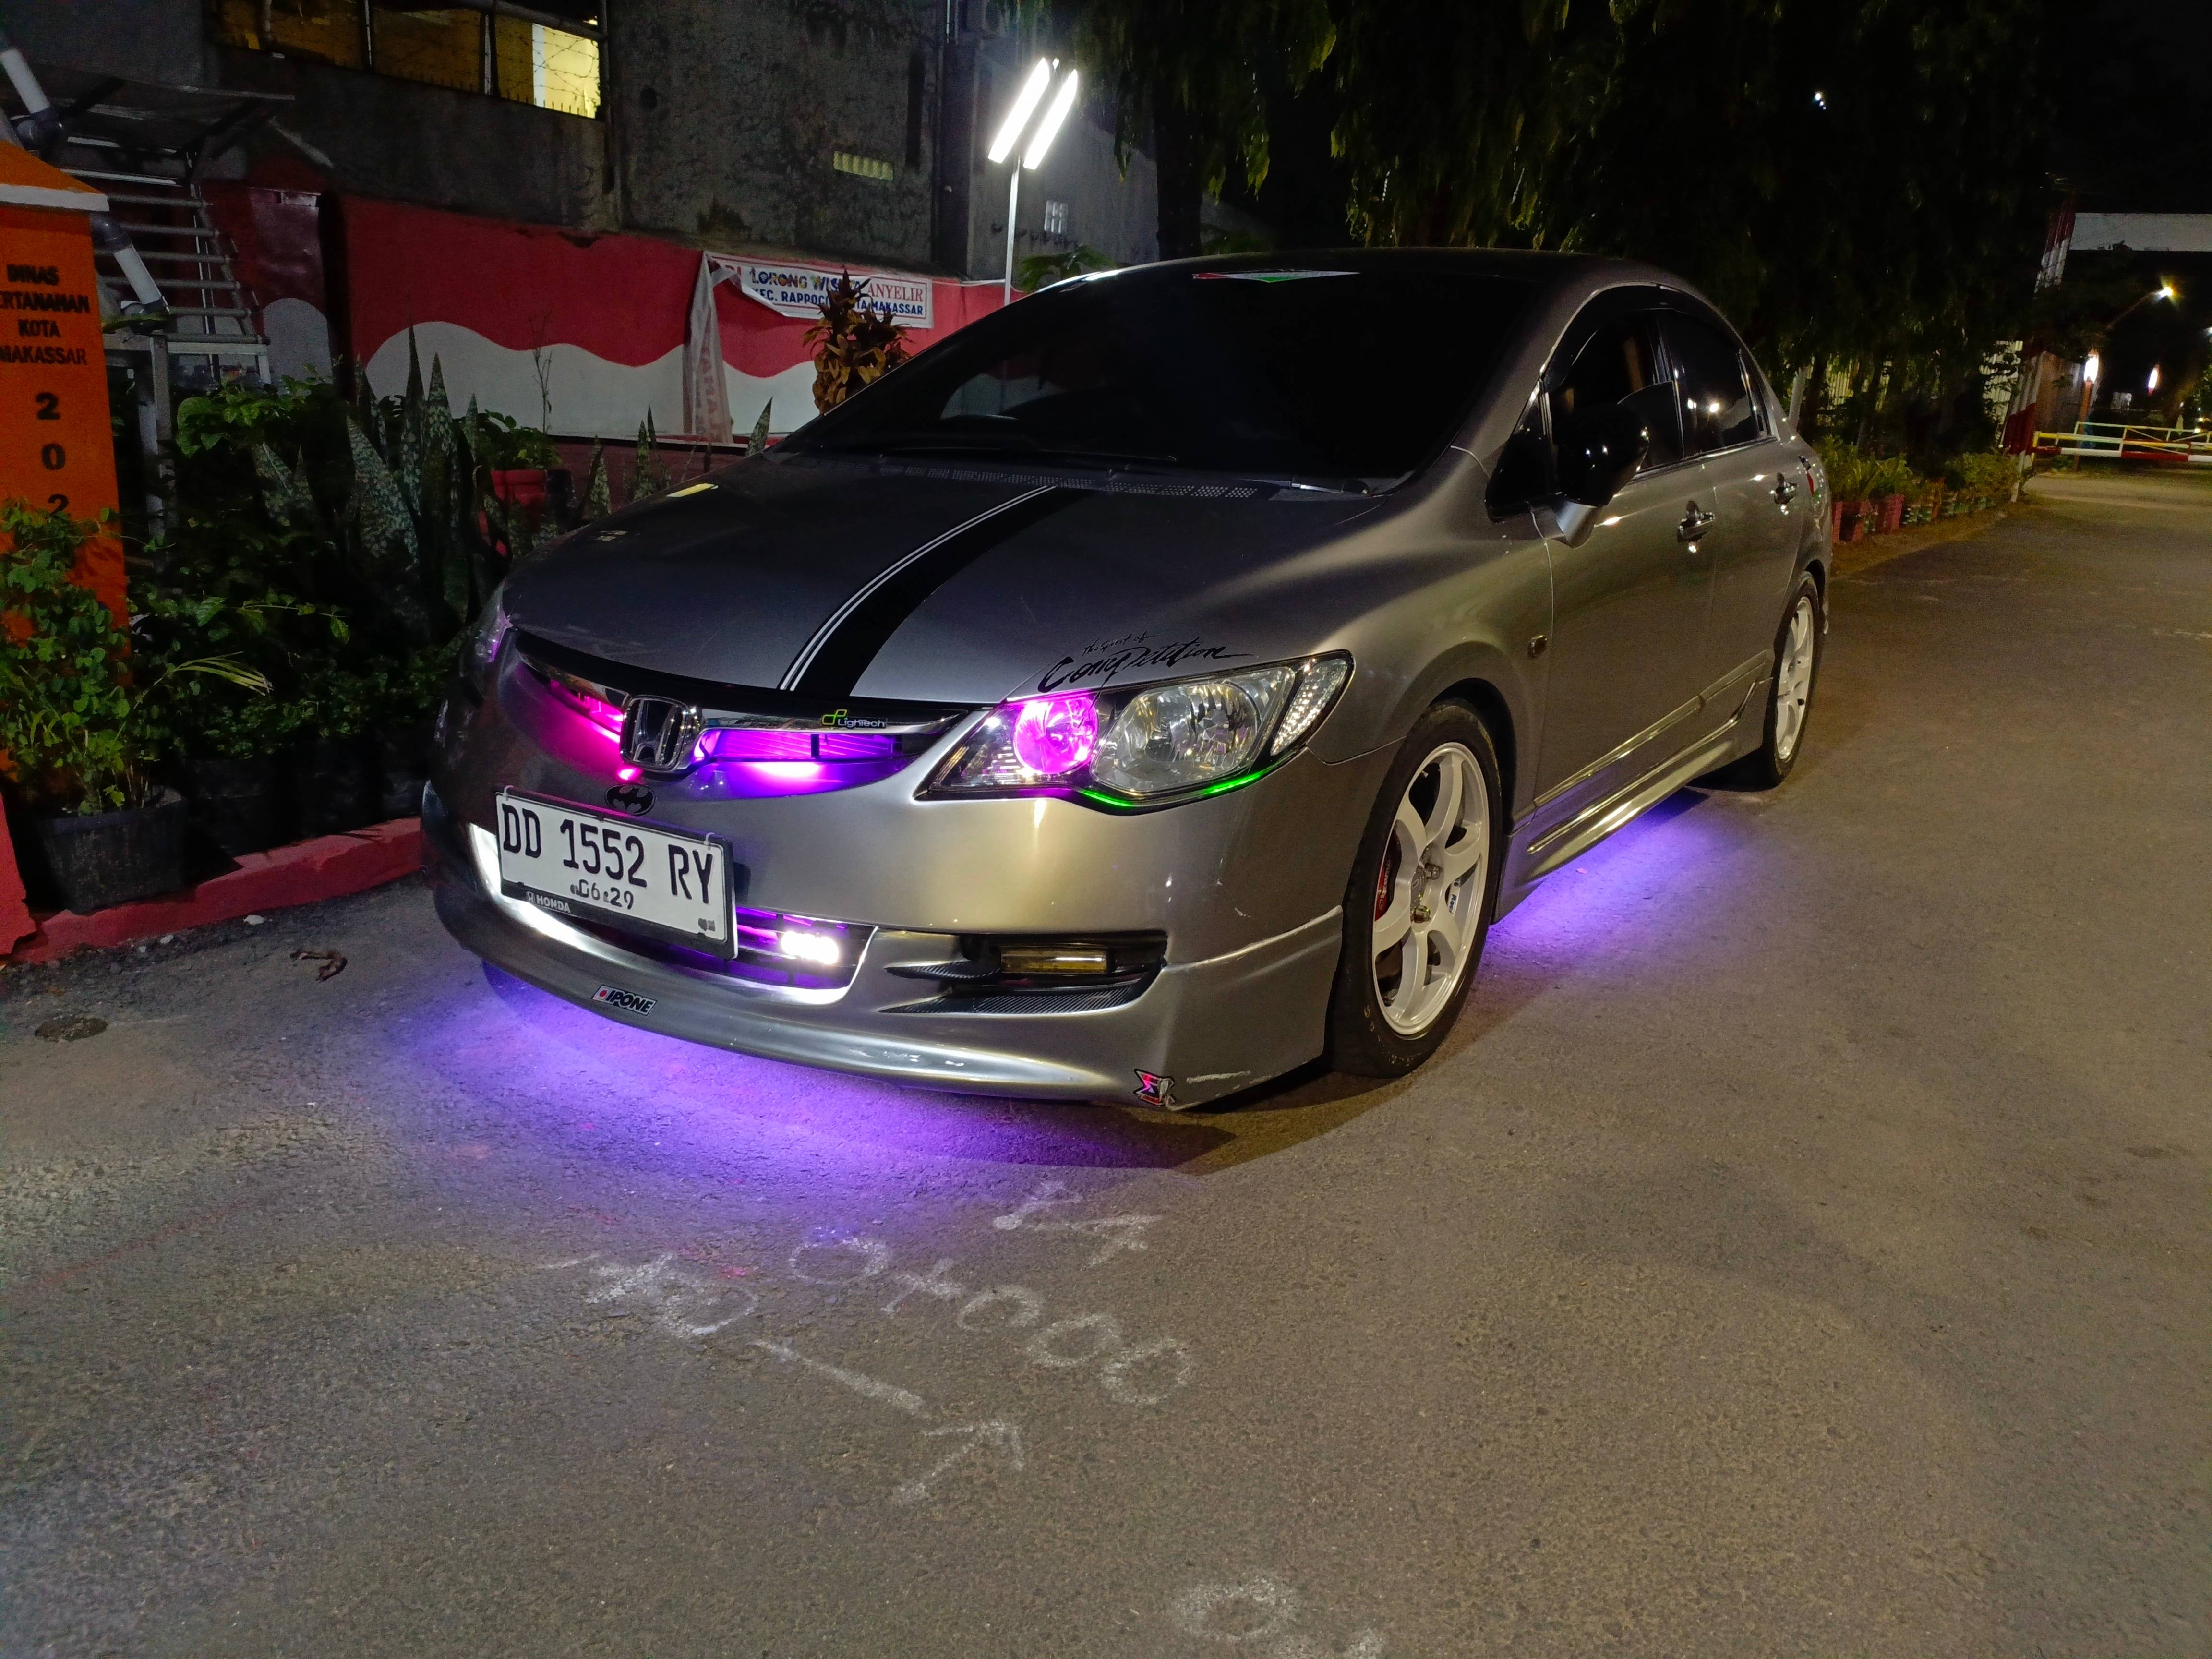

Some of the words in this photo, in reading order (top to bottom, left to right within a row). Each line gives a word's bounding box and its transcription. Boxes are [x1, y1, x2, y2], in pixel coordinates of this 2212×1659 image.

[7, 264, 59, 286] DINAS
[749, 266, 807, 289] LORONG
[871, 300, 923, 315] MAKASSAR
[18, 318, 61, 338] KOTA
[502, 803, 542, 859] DD
[560, 818, 648, 888] 1552
[668, 843, 713, 905] RY
[536, 894, 571, 913] HONDA
[605, 990, 654, 1014] IPONE
